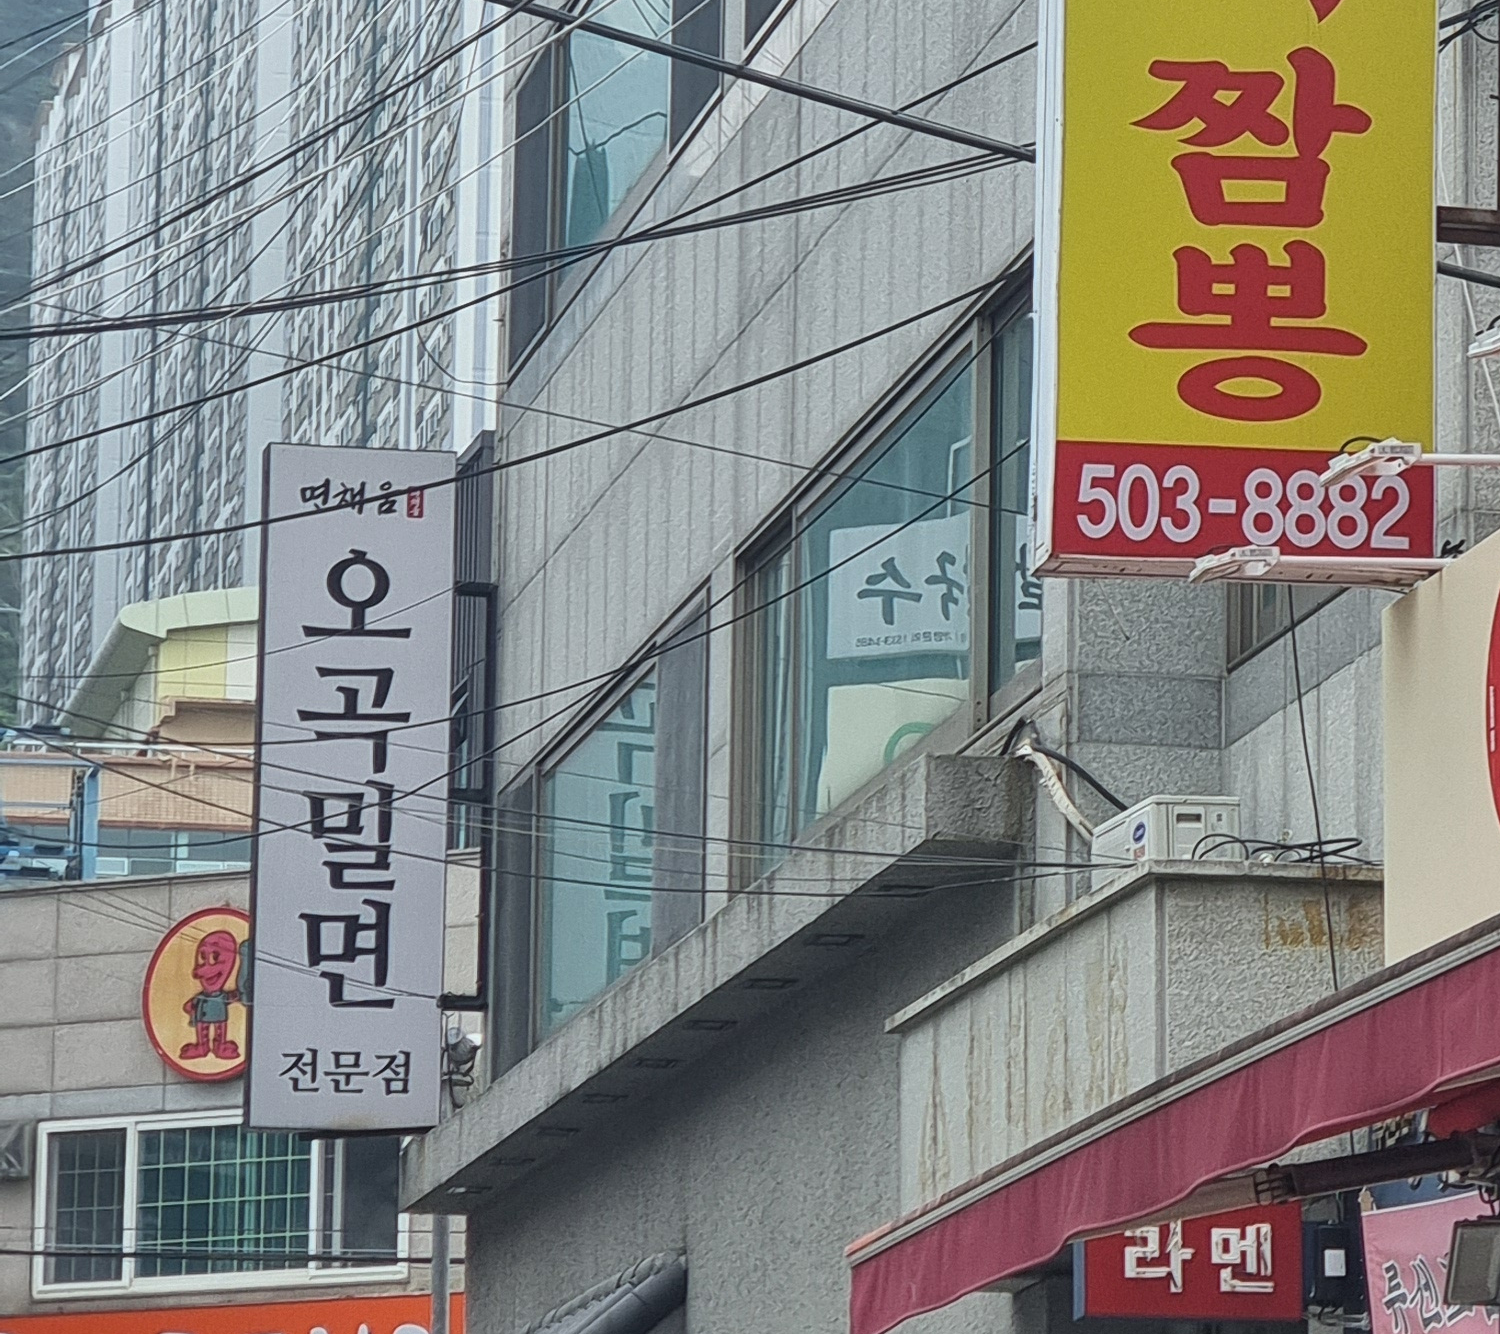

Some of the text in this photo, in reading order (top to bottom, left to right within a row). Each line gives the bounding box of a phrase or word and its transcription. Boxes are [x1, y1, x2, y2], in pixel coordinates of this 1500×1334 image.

[1129, 47, 1372, 422] 짬뽕
[1076, 463, 1410, 551] 503-8882
[296, 548, 412, 1009] 오곡밀면
[279, 1048, 412, 1097] 전문점
[1124, 1219, 1274, 1293] 라멘
